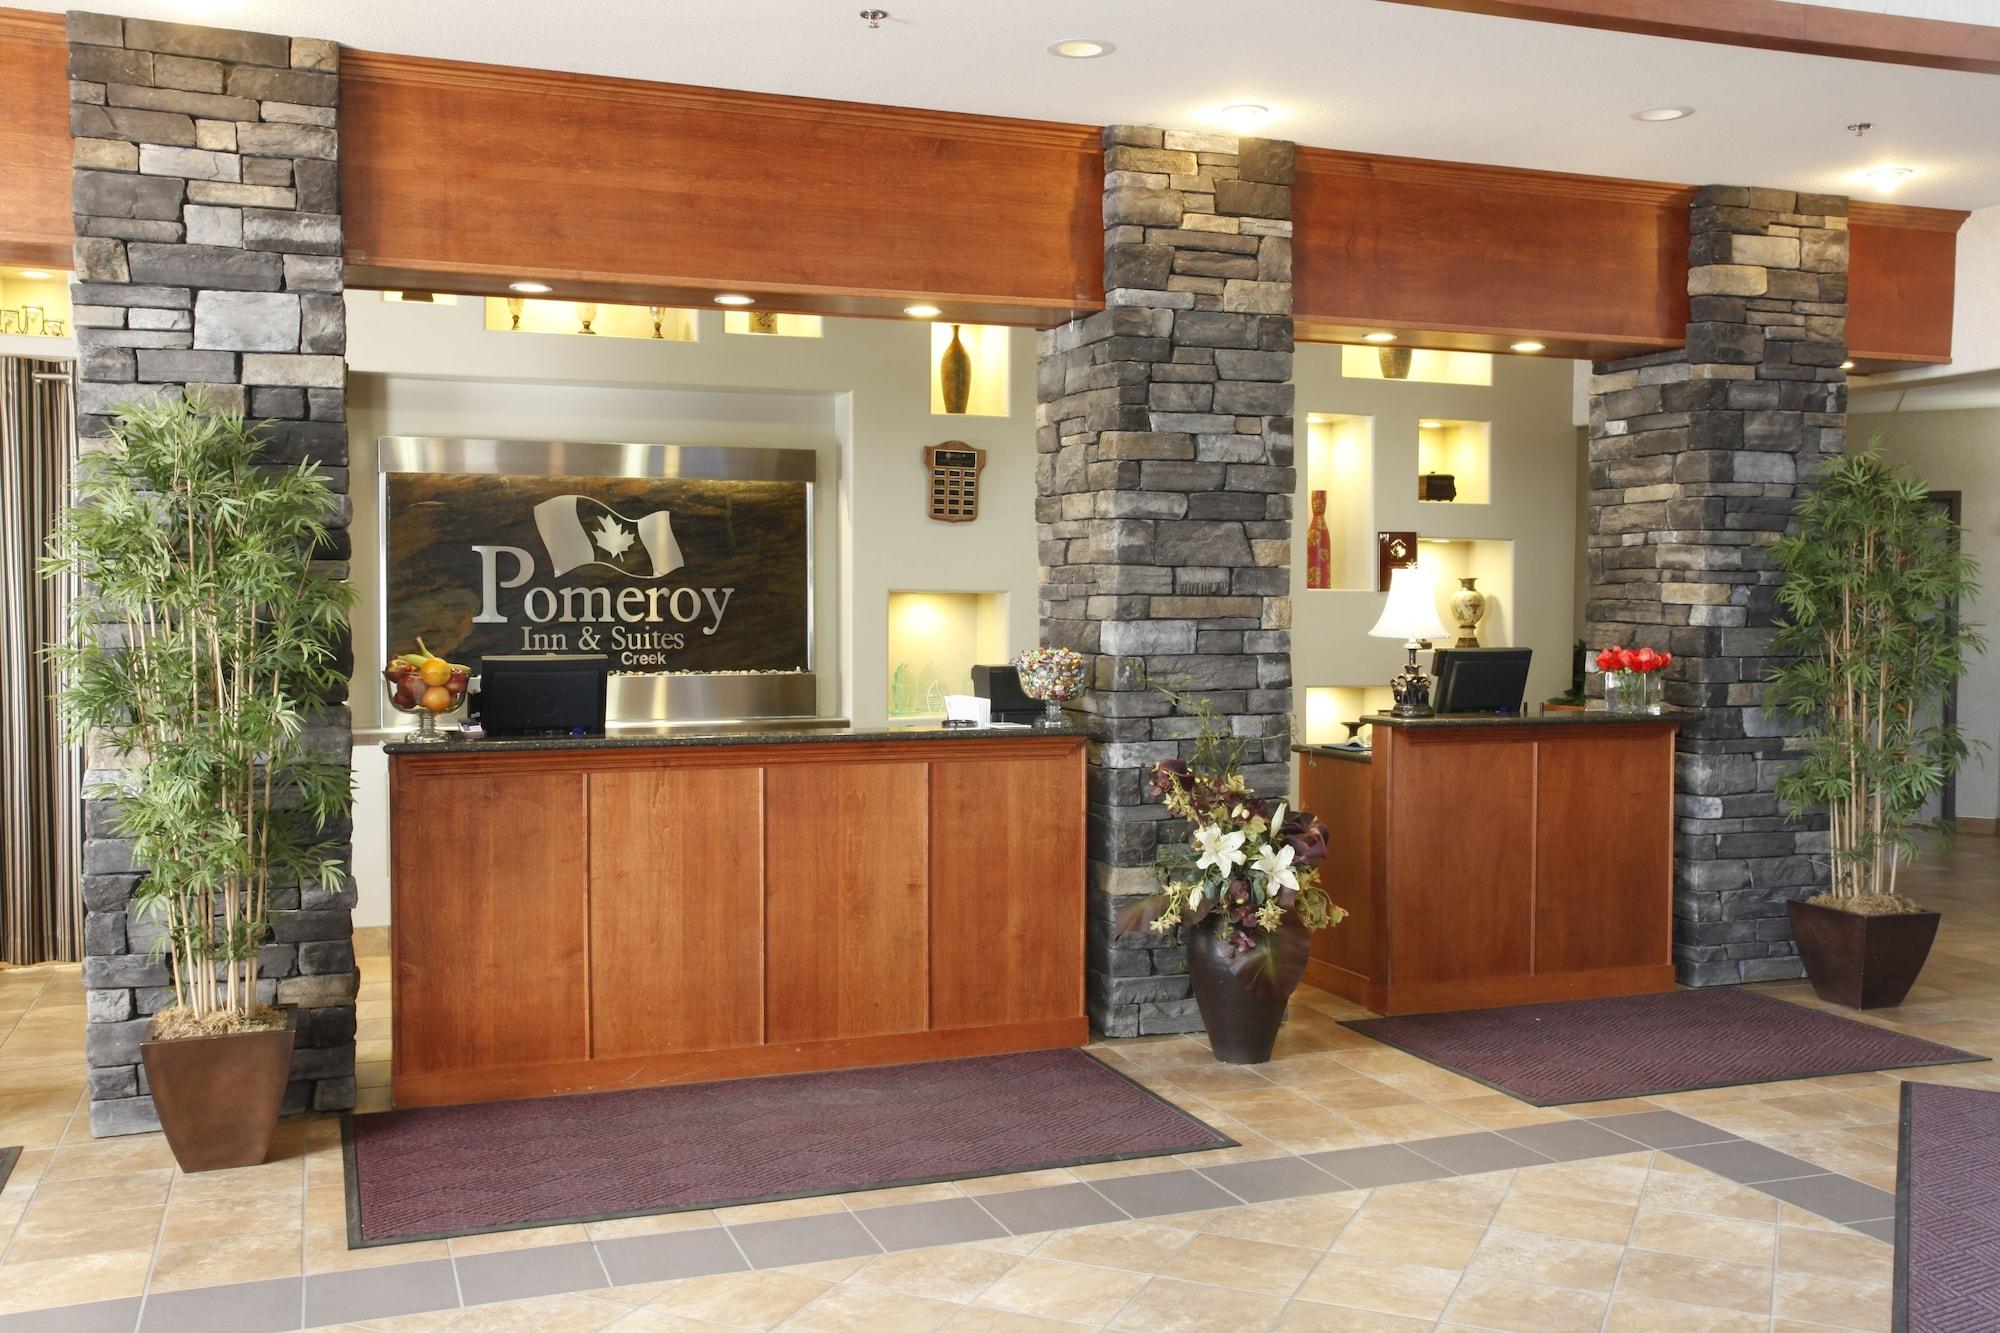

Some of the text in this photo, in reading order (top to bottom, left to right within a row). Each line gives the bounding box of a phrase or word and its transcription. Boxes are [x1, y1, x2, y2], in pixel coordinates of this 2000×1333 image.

[472, 545, 736, 636] Pomeroy
[521, 626, 685, 651] Inn & Suites
[621, 651, 667, 665] Creek
